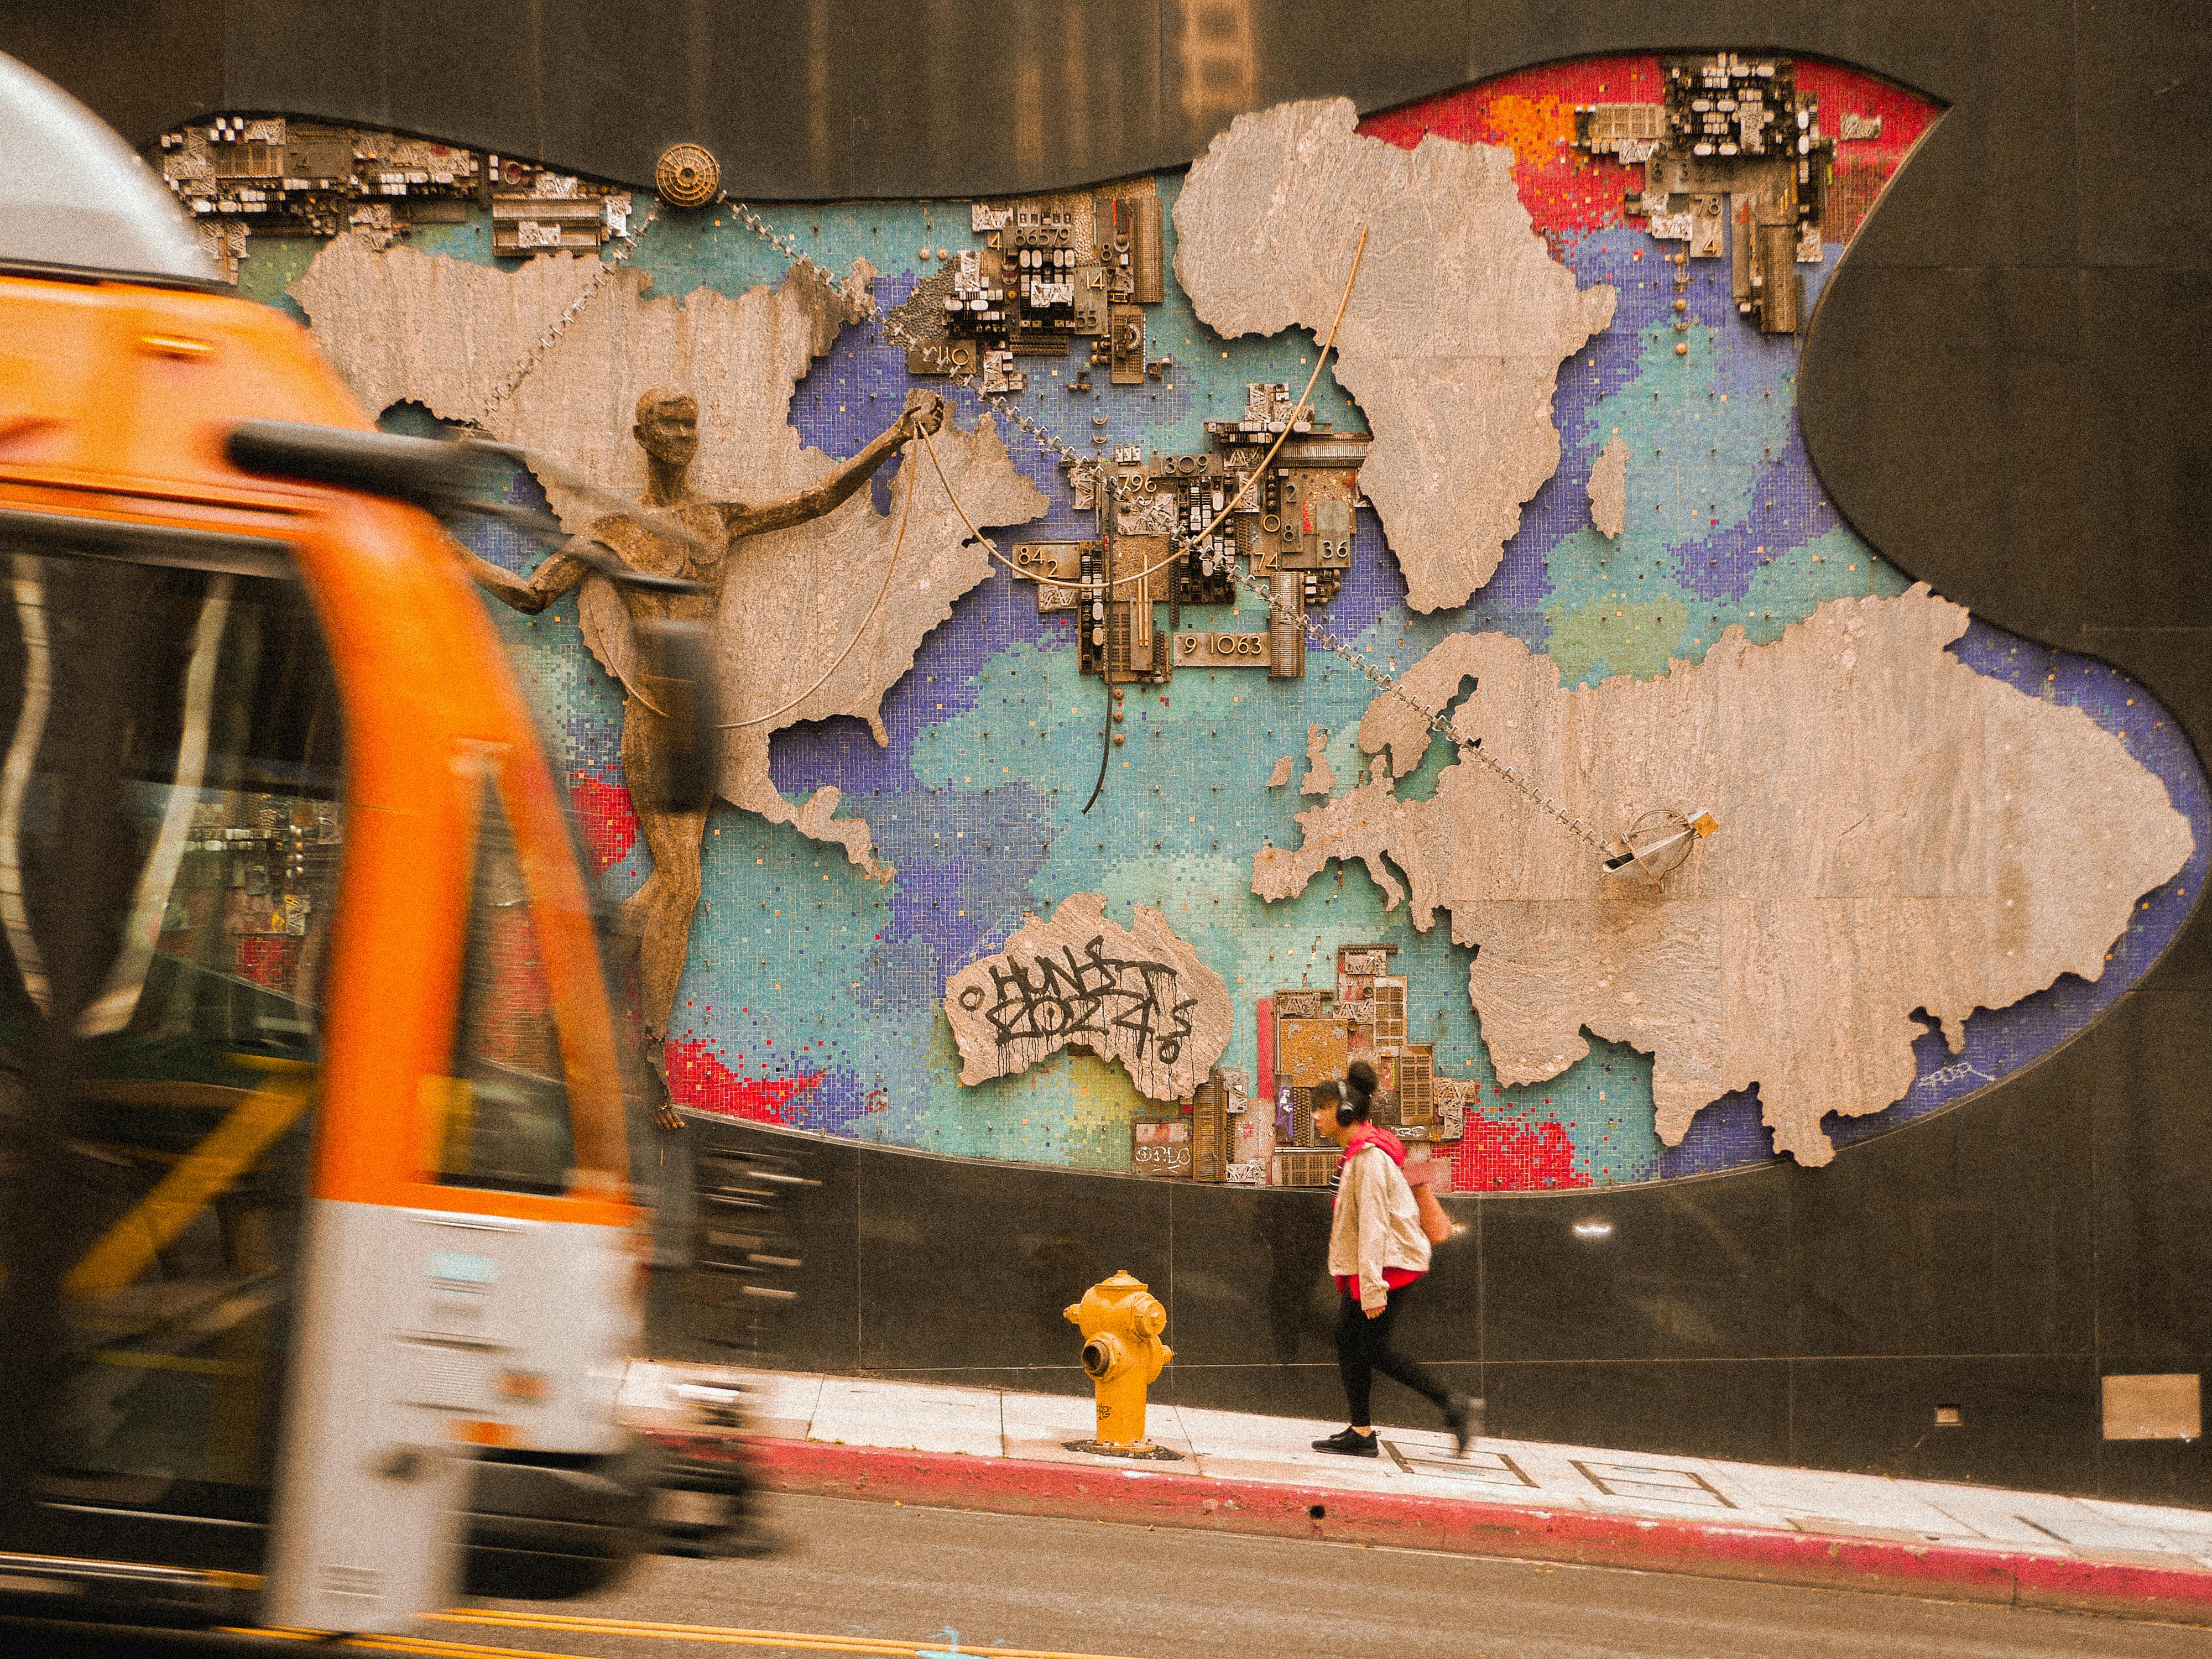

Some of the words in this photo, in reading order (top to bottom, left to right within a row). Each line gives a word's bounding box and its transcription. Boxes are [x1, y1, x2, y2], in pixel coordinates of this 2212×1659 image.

[1693, 197, 1720, 215] 78
[988, 231, 1003, 251] 4
[1015, 228, 1070, 246] 86579
[1703, 238, 1718, 254] 4
[1100, 244, 1113, 261] 8
[1086, 269, 1105, 290] 14
[1077, 310, 1098, 327] 55
[1119, 474, 1157, 493] 796
[1286, 482, 1297, 503] 2
[1019, 546, 1045, 564] 84
[1322, 540, 1348, 559] 36
[1047, 559, 1058, 577] 2
[1254, 551, 1280, 571] 74
[1185, 637, 1197, 654] 9
[1211, 636, 1262, 654] 1063
